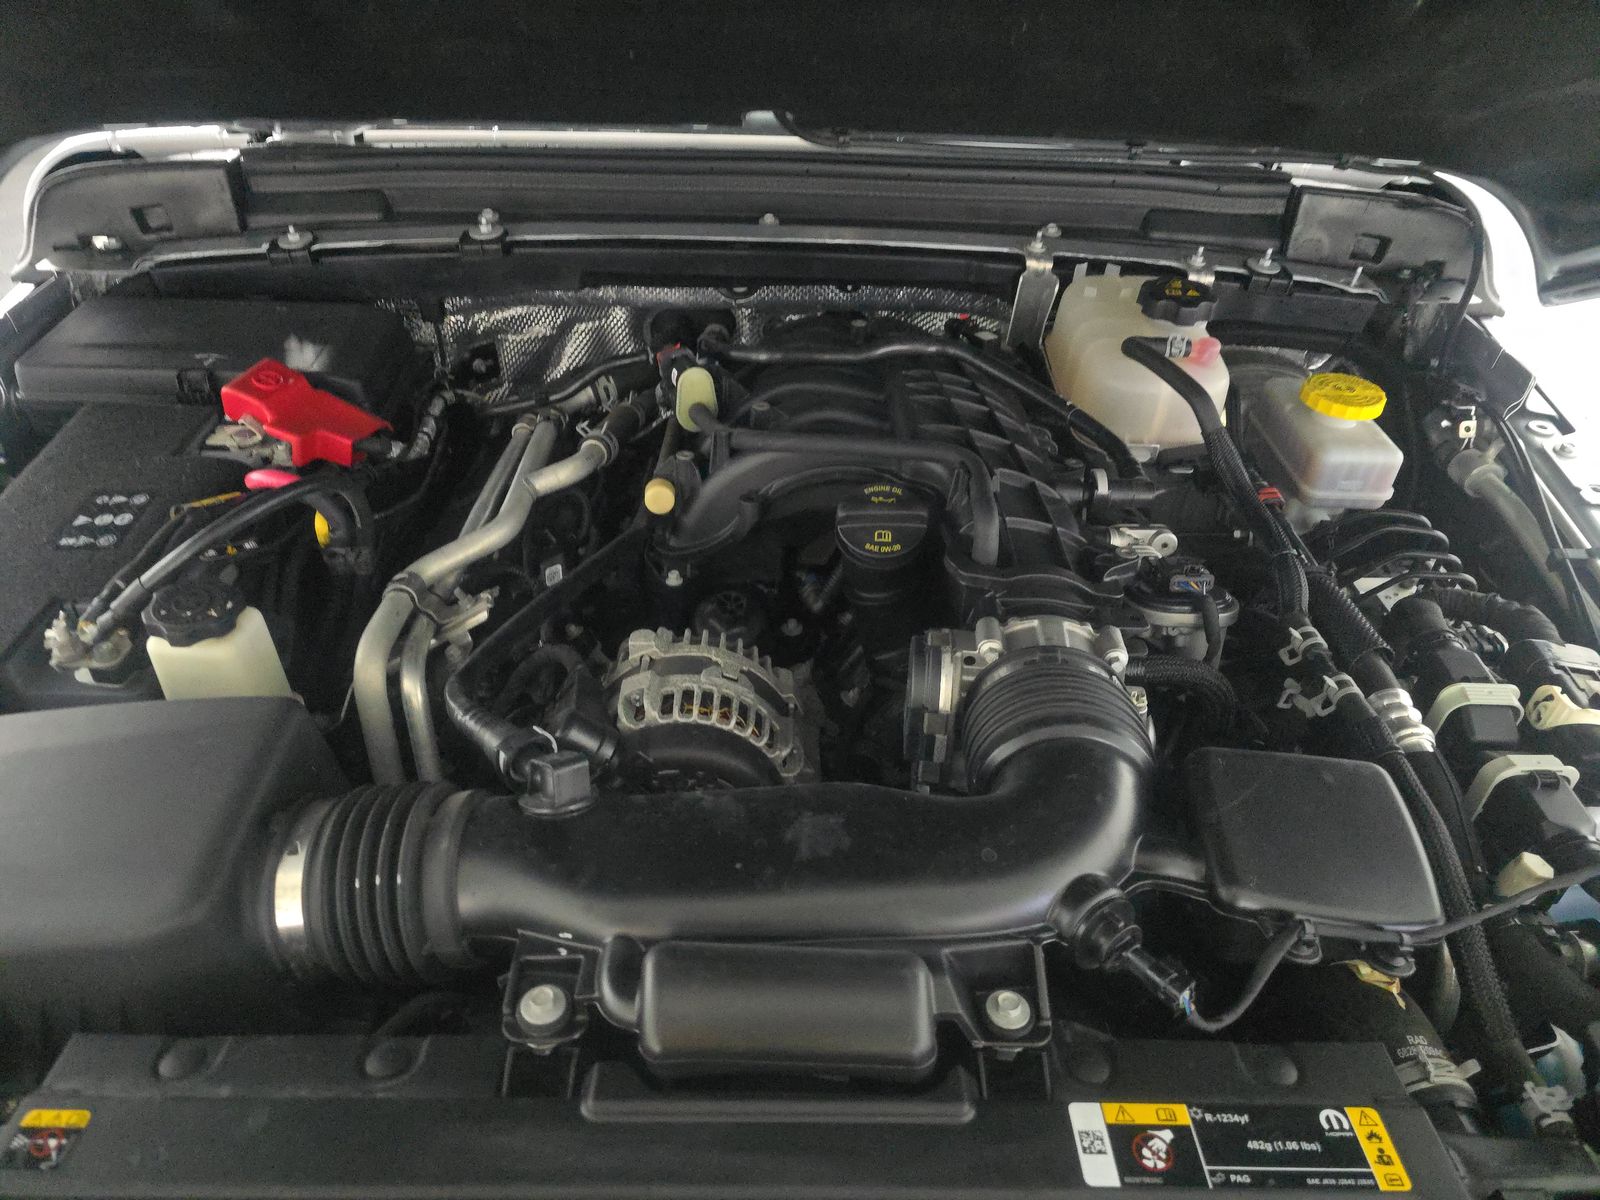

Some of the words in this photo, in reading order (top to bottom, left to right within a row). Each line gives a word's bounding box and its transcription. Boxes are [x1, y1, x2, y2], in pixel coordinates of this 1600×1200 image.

[864, 485, 891, 495] ENGINE
[892, 486, 903, 496] OIL
[864, 542, 879, 553] SAE
[1406, 1035, 1428, 1045] RAD
[1204, 1113, 1250, 1125] R-1234yf
[1247, 1140, 1272, 1152] 482g
[1300, 1141, 1322, 1152] lbs)
[1229, 1174, 1251, 1183] PAG
